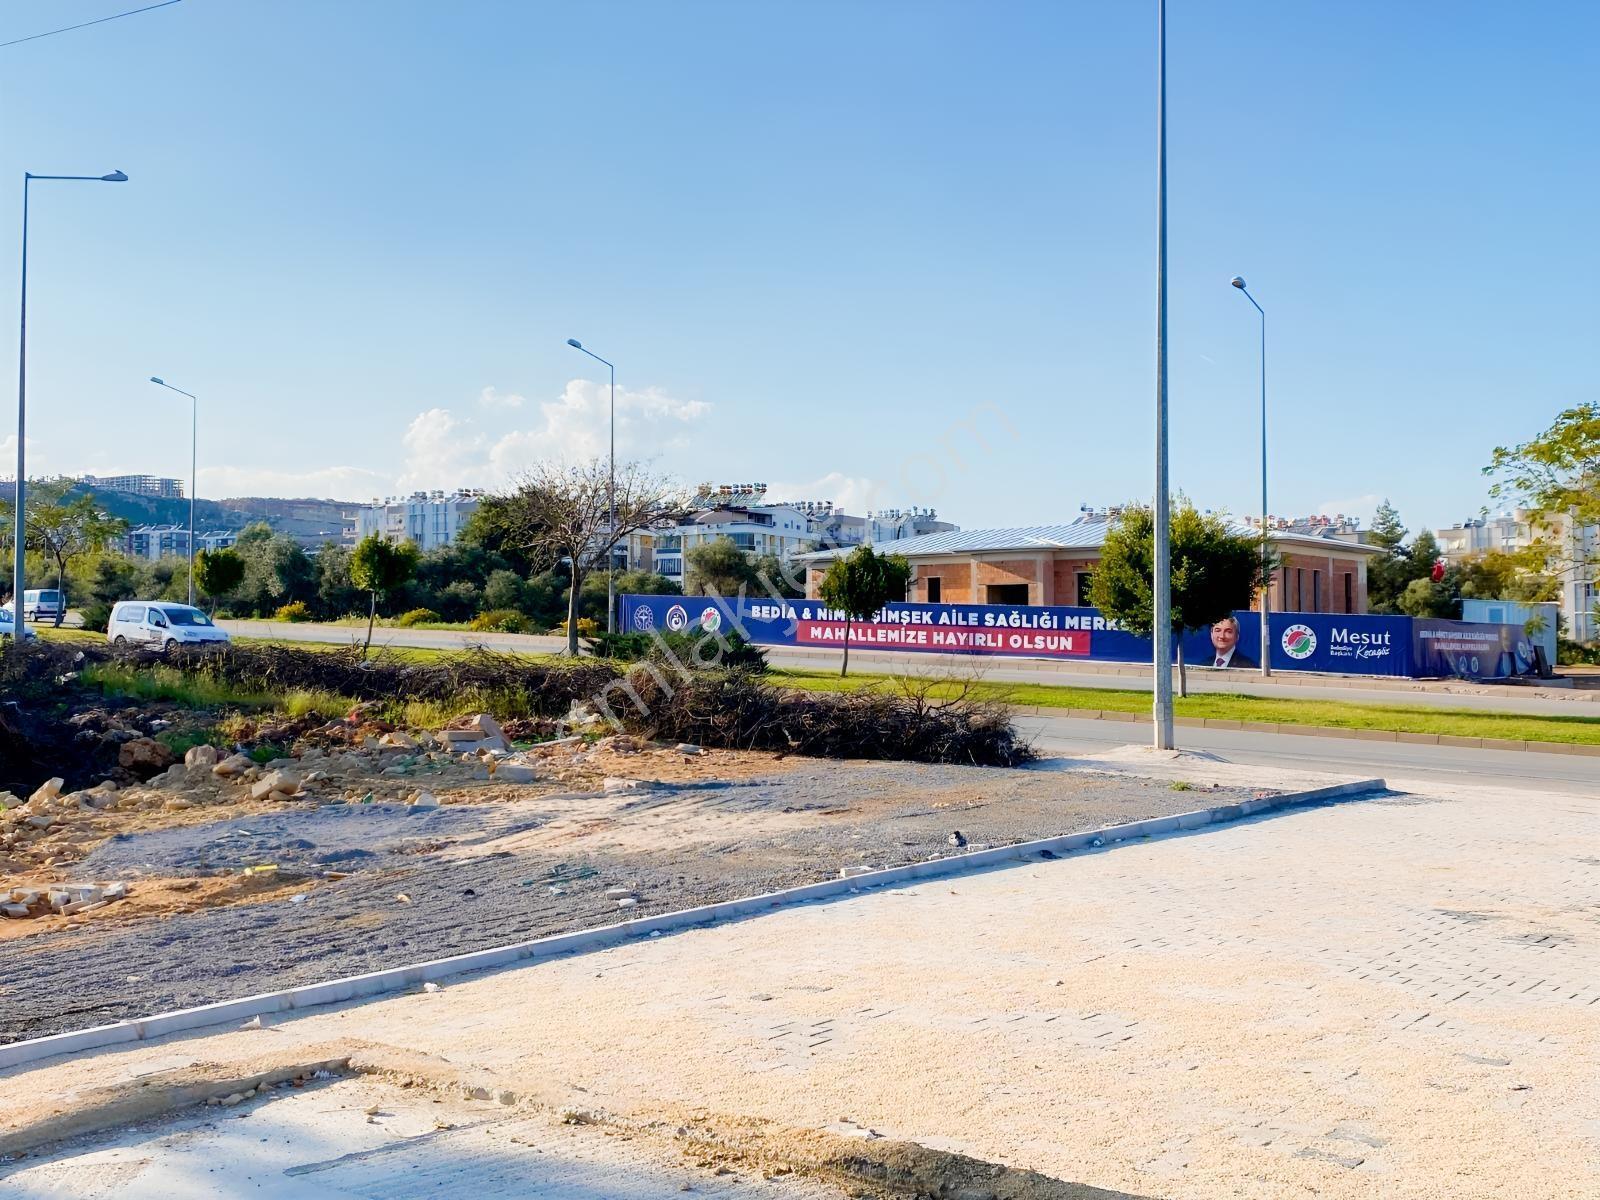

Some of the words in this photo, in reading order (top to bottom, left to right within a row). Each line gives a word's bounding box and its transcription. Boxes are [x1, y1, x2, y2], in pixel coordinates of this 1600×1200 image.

[751, 604, 797, 619] BEDİA
[802, 607, 811, 619] &
[872, 607, 933, 625] ŞİMŞEK
[938, 609, 978, 626] AİLE
[984, 611, 1058, 629] SAĞLIĞI
[811, 626, 927, 644] MAHALLEMİZE
[933, 631, 1002, 648] HAYIRLI
[1009, 635, 1073, 651] OLSUN
[1331, 628, 1391, 645] Mesut
